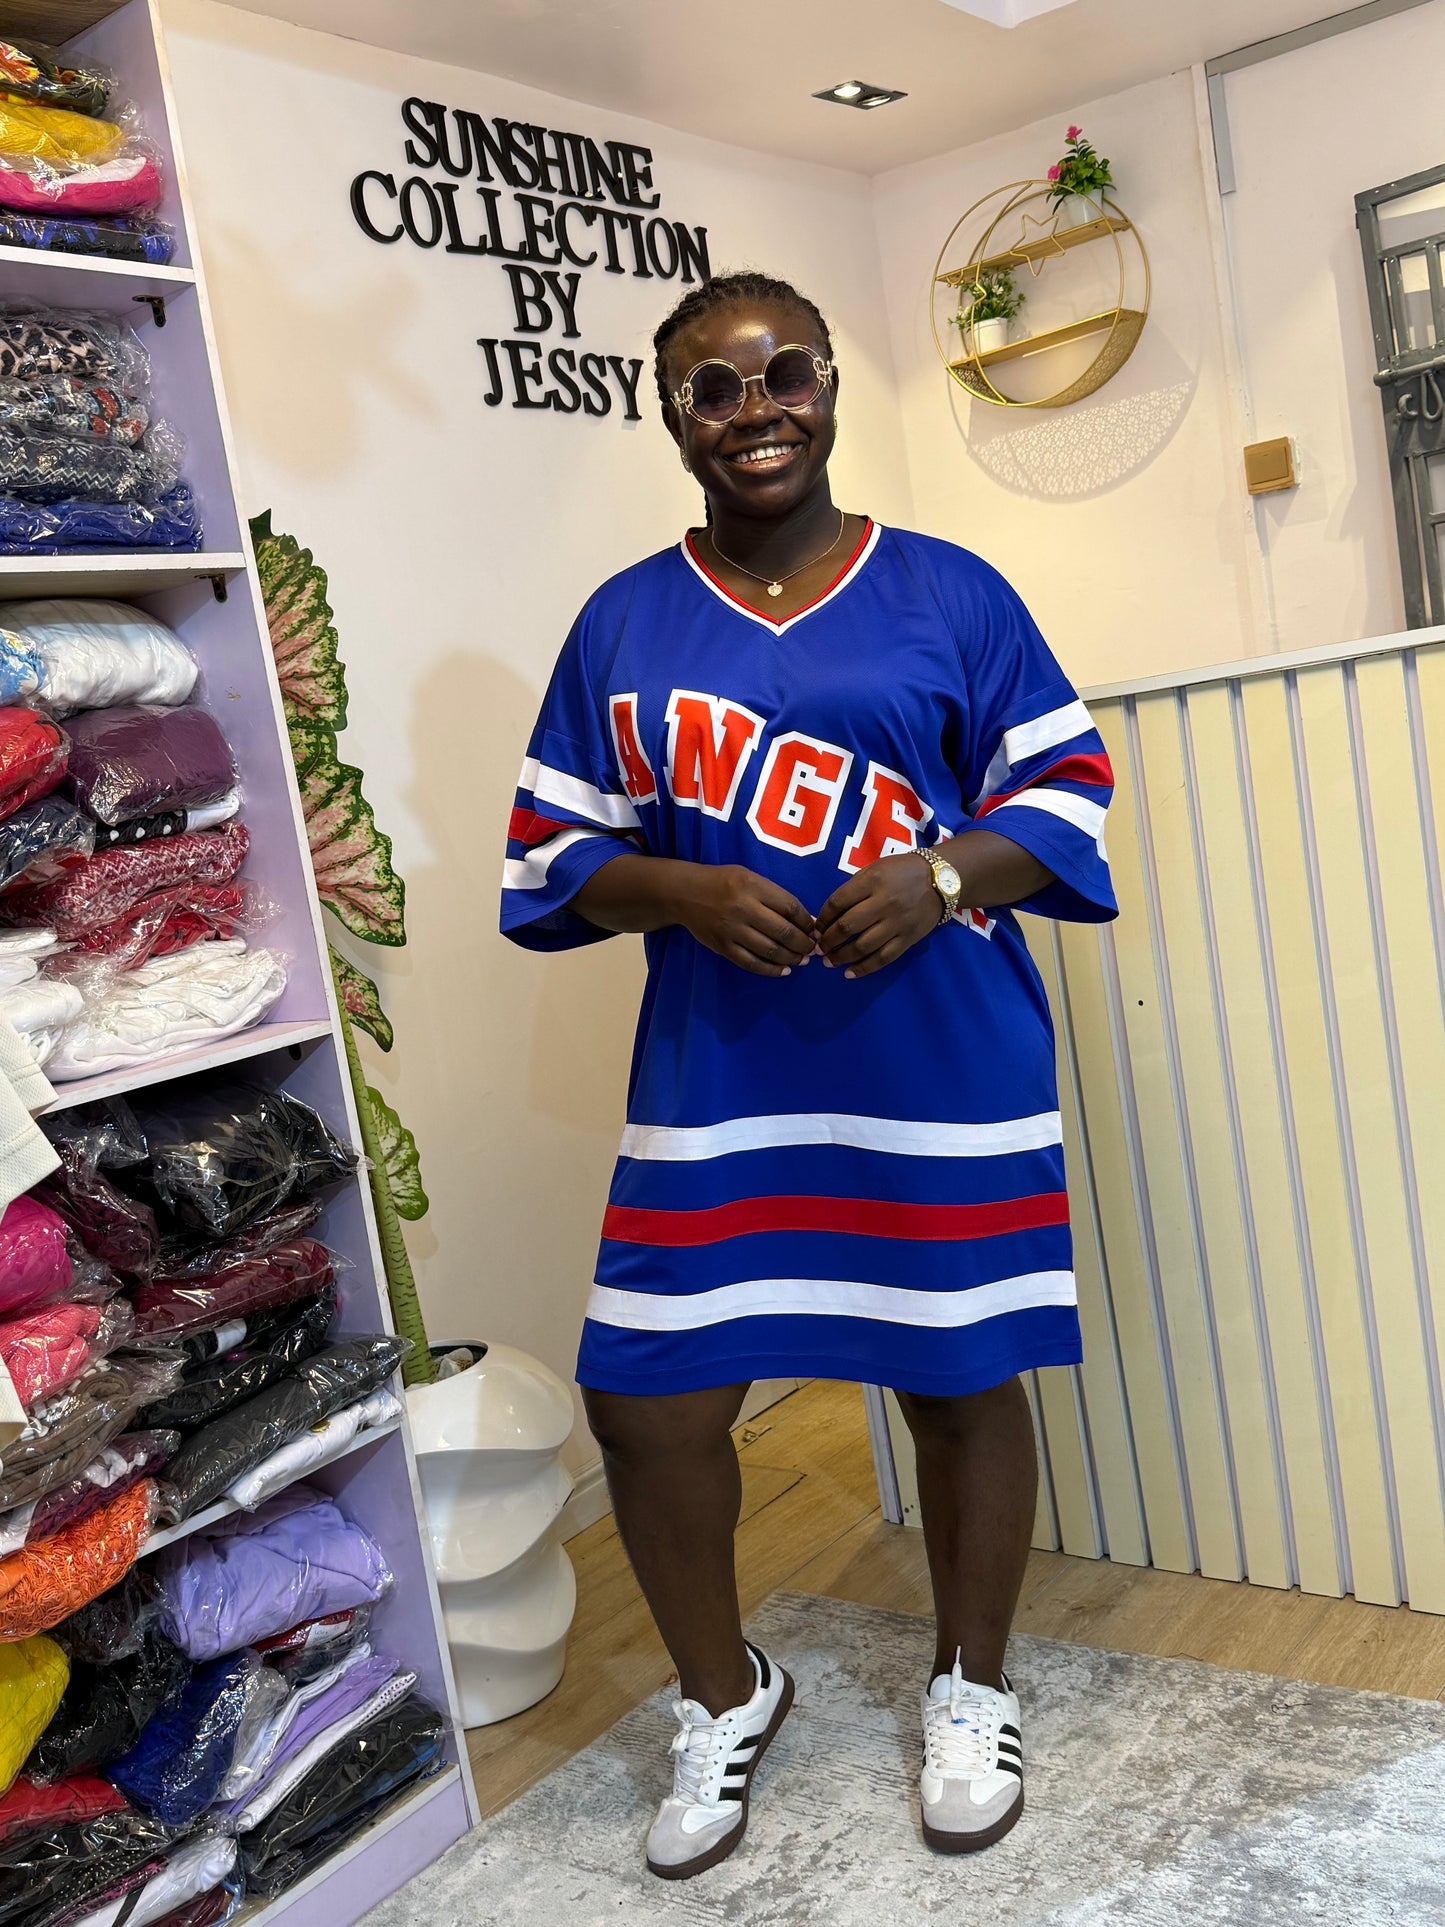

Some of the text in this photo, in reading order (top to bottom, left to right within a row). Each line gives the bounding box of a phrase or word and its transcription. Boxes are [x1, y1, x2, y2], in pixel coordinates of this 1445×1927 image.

[401, 97, 660, 209] SUNSHINE
[350, 170, 711, 283] COLLECTION
[502, 264, 581, 338] BY
[477, 338, 643, 420] JESSY
